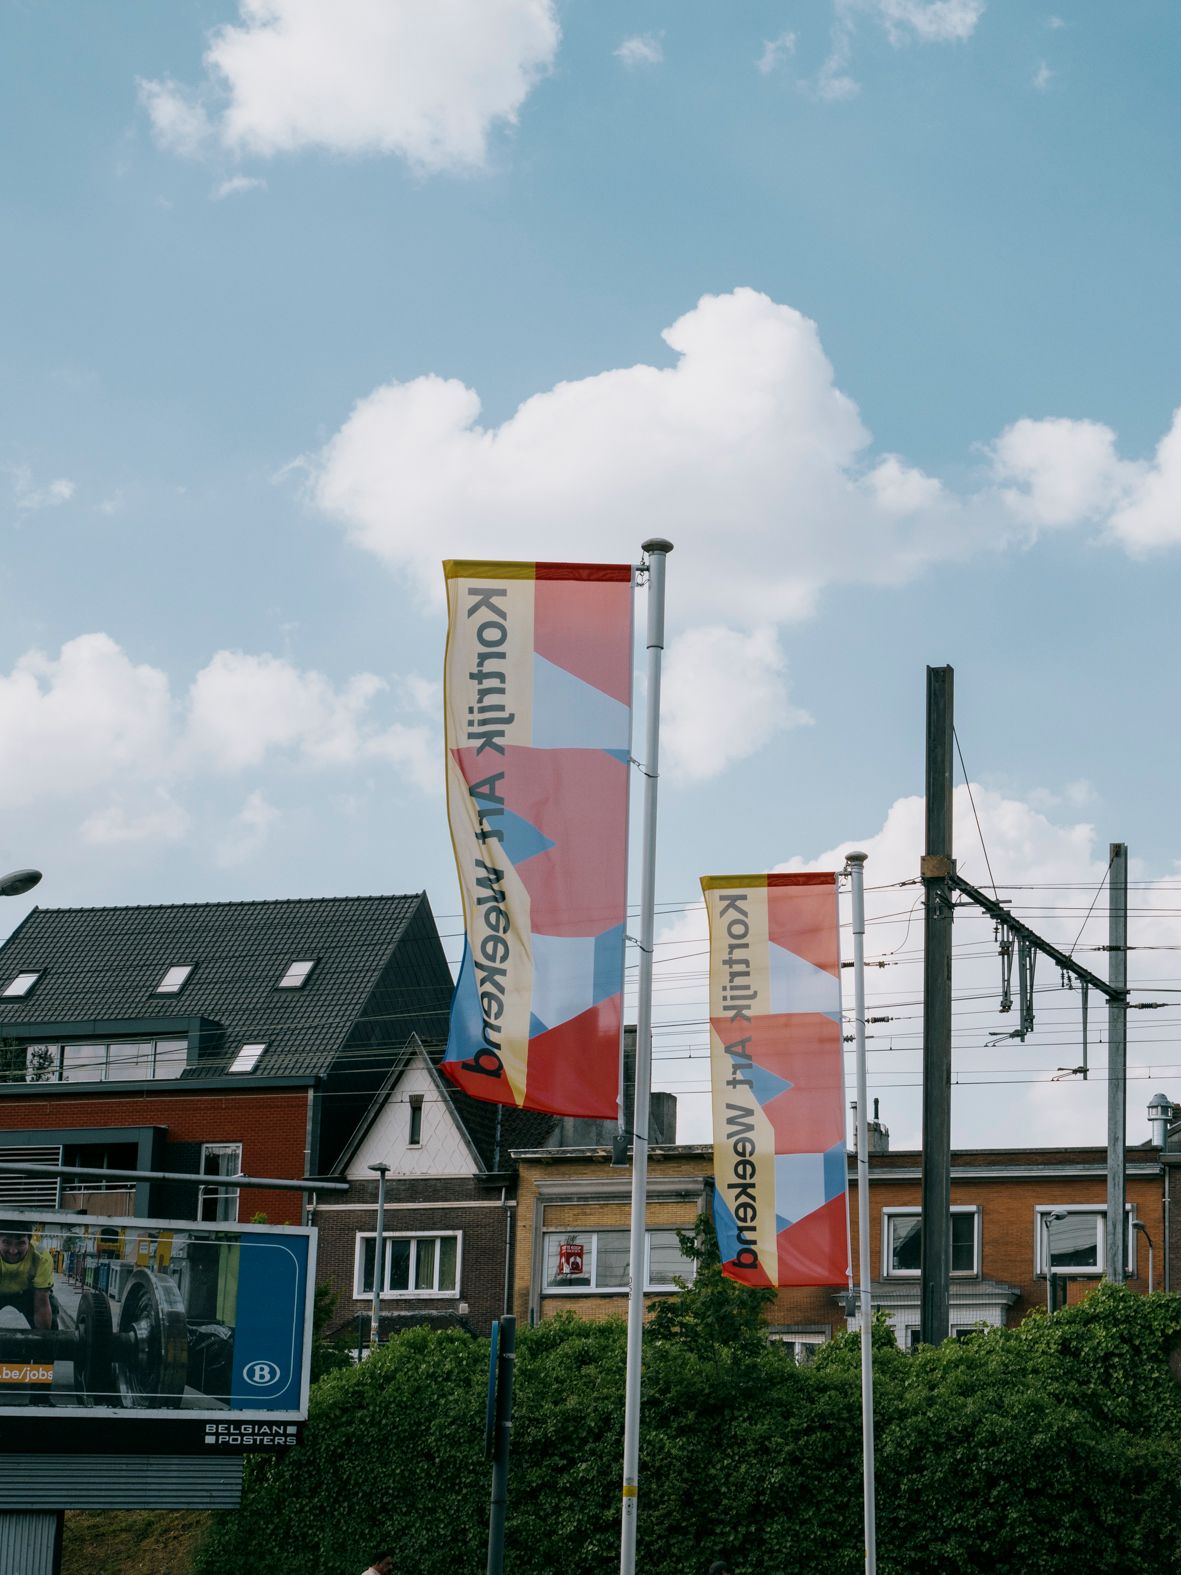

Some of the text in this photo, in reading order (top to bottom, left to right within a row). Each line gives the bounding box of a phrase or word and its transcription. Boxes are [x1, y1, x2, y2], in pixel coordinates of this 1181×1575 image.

[252, 1364, 271, 1382] B
[205, 1424, 284, 1434] BELGIAN
[218, 1435, 297, 1445] POSTERS
